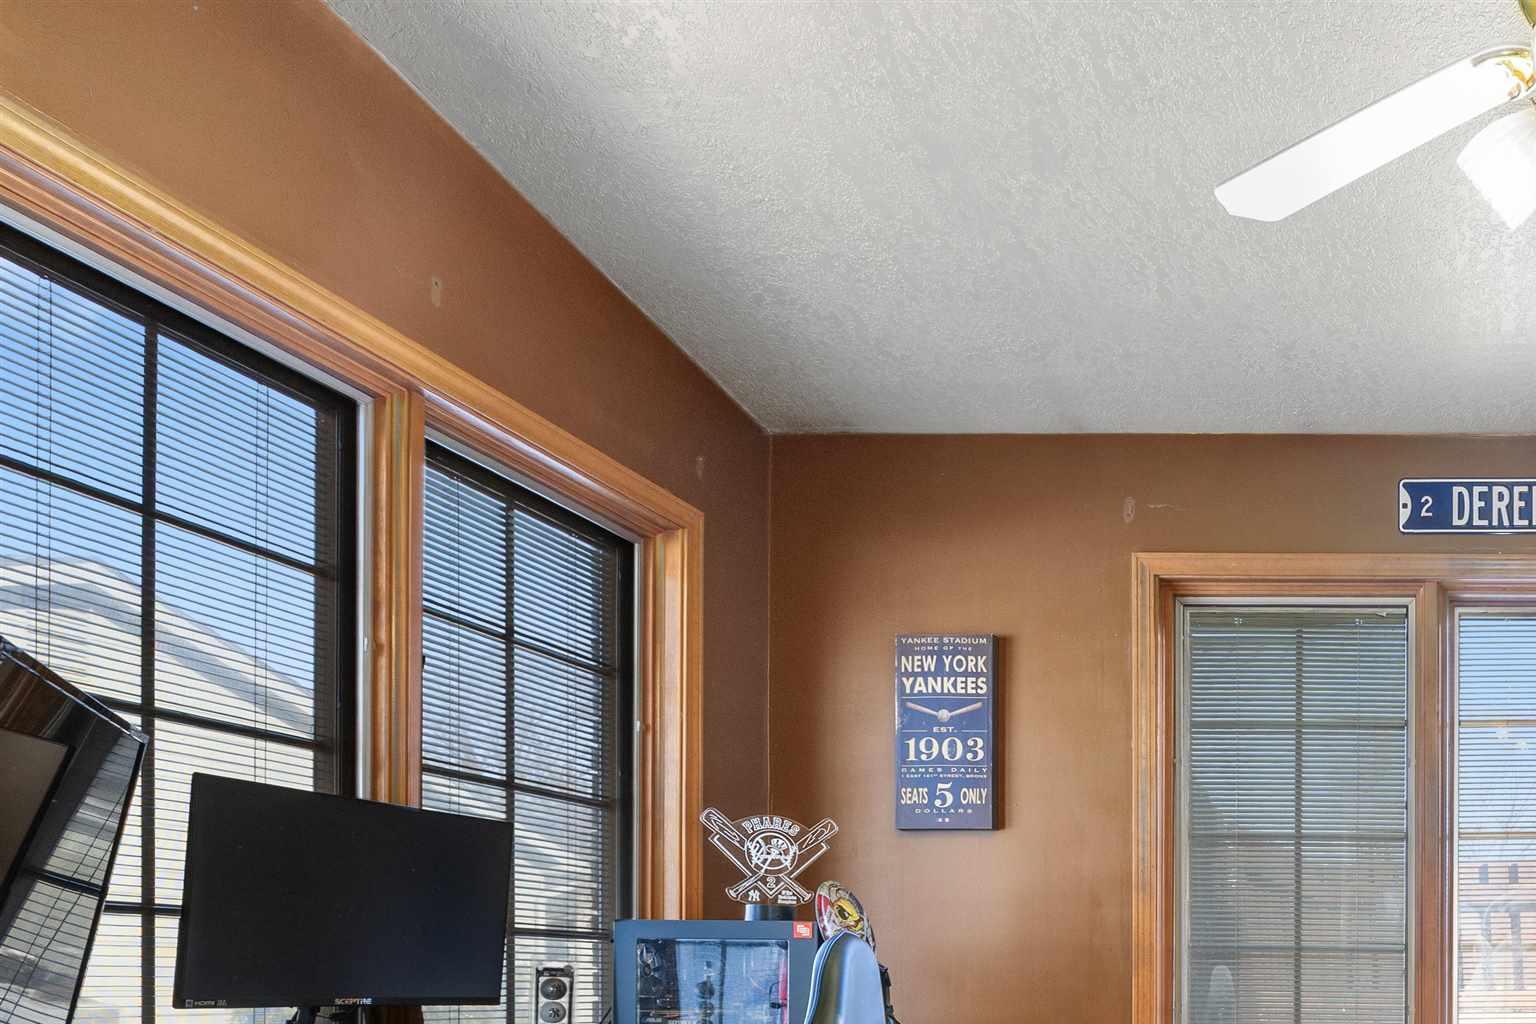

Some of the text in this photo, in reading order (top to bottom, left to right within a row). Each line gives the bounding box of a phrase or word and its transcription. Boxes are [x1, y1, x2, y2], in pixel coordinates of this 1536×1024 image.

[1420, 496, 1433, 517] 2
[901, 636, 987, 645] YANKEE STADIUM
[901, 655, 987, 673] NEW YORK
[901, 676, 988, 694] YANKEES
[904, 736, 985, 762] 1903
[900, 781, 987, 808] SEATS 5 ONLY
[741, 816, 801, 837] PHARES
[766, 876, 776, 889] 2
